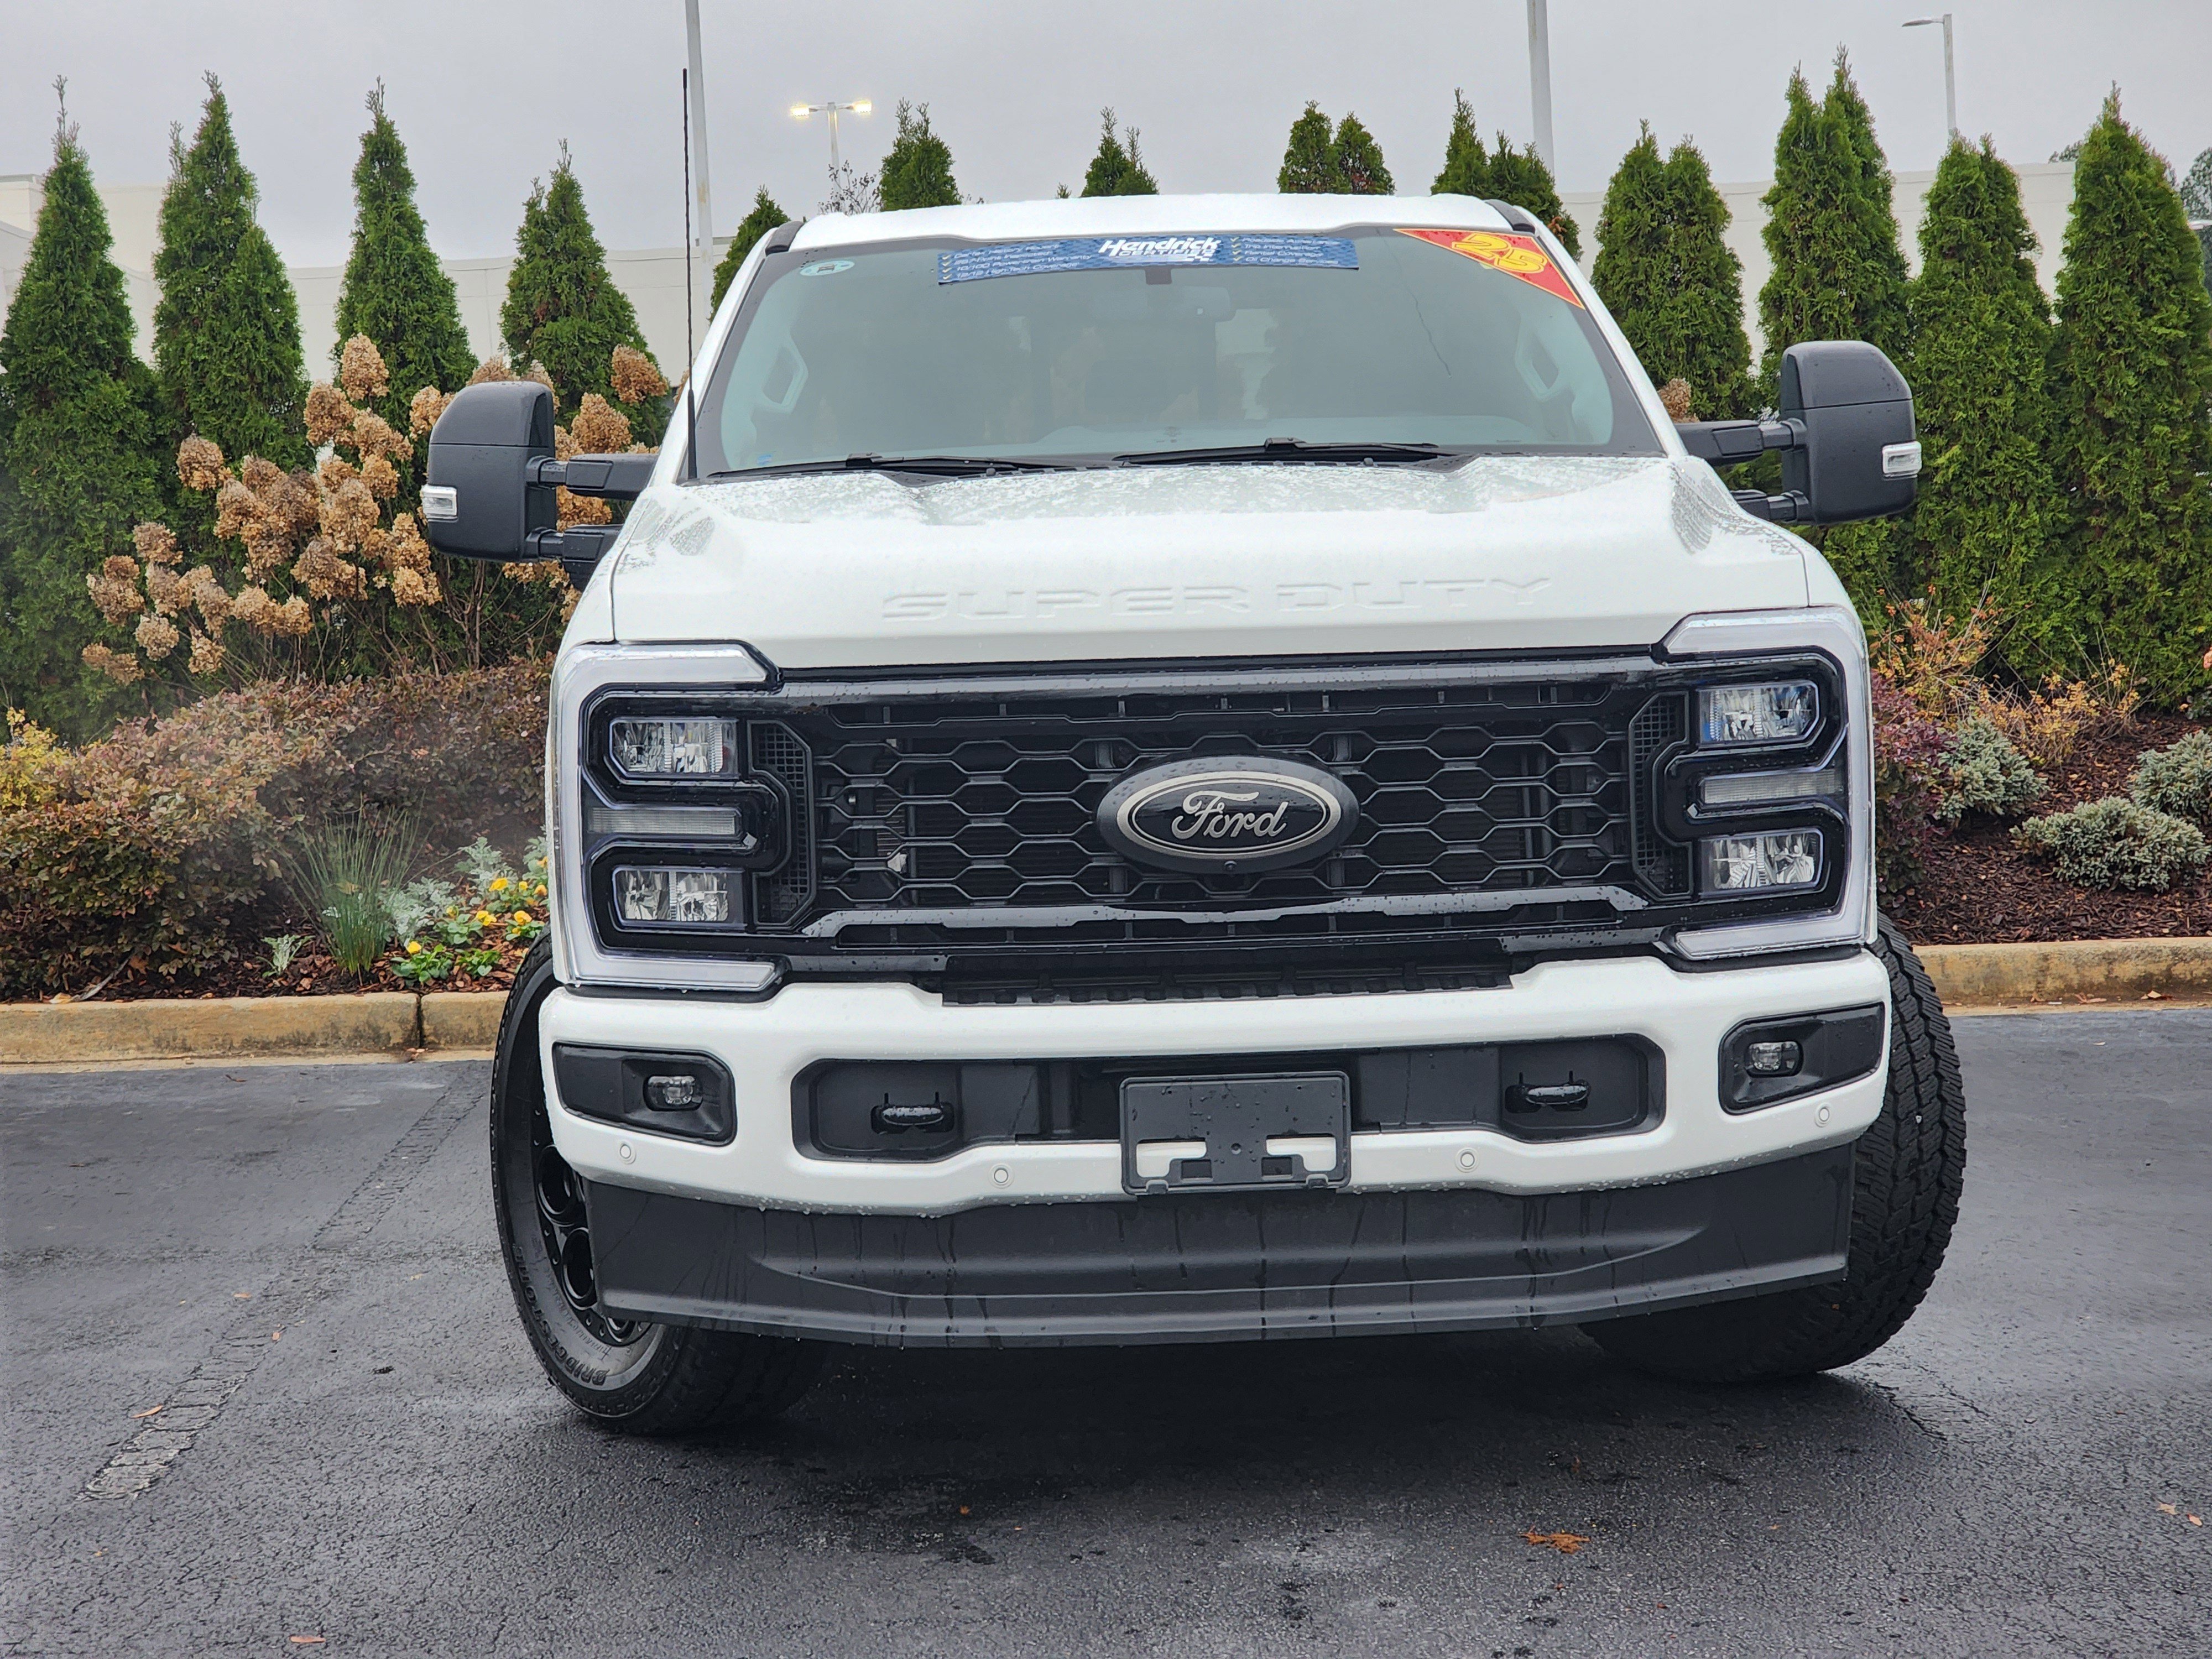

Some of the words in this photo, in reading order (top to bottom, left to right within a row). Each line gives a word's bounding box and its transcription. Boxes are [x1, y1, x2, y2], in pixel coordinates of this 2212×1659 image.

[1098, 237, 1222, 257] Hendrick
[1452, 232, 1548, 274] 25
[882, 586, 1251, 622] SUPER
[1276, 577, 1552, 612] DUTY
[1171, 790, 1289, 839] Ford
